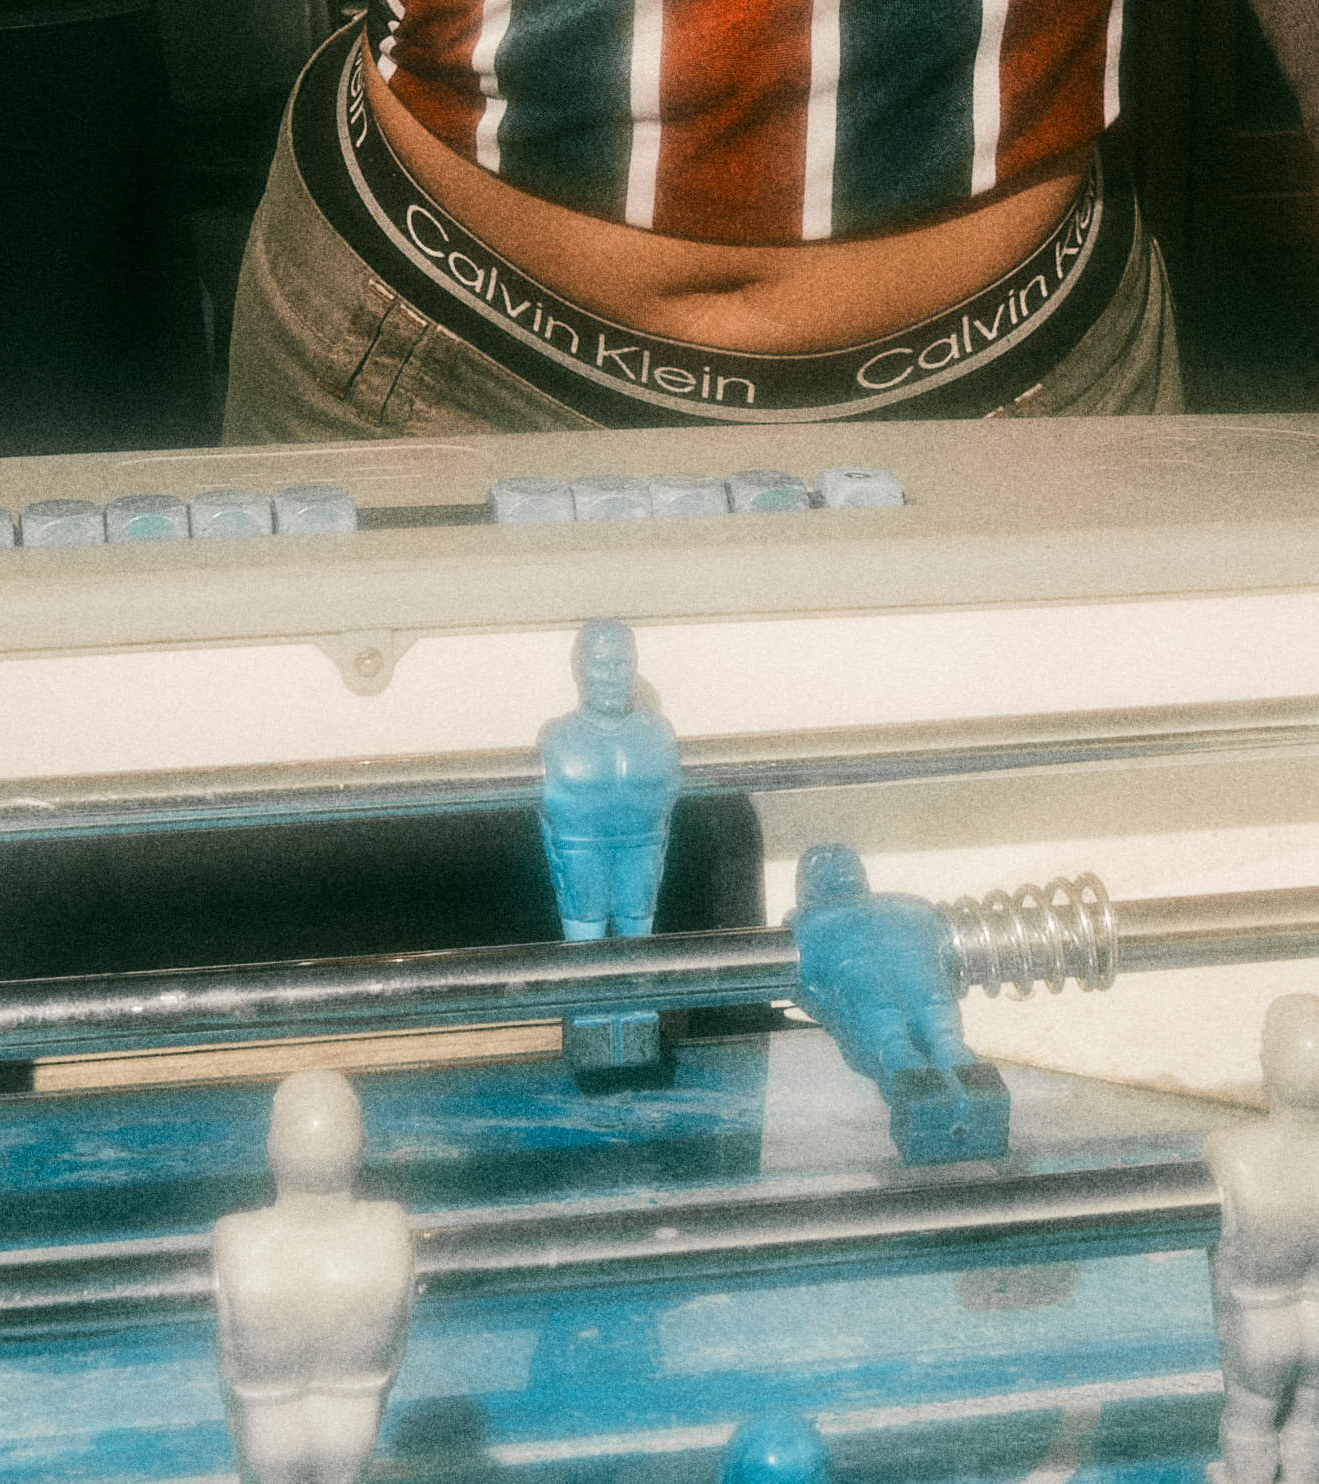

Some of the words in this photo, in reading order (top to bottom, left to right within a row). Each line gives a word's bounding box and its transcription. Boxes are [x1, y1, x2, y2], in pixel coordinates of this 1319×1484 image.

[403, 202, 580, 355] Calvin
[596, 332, 756, 405] Klein
[856, 275, 1050, 394] Calvin
